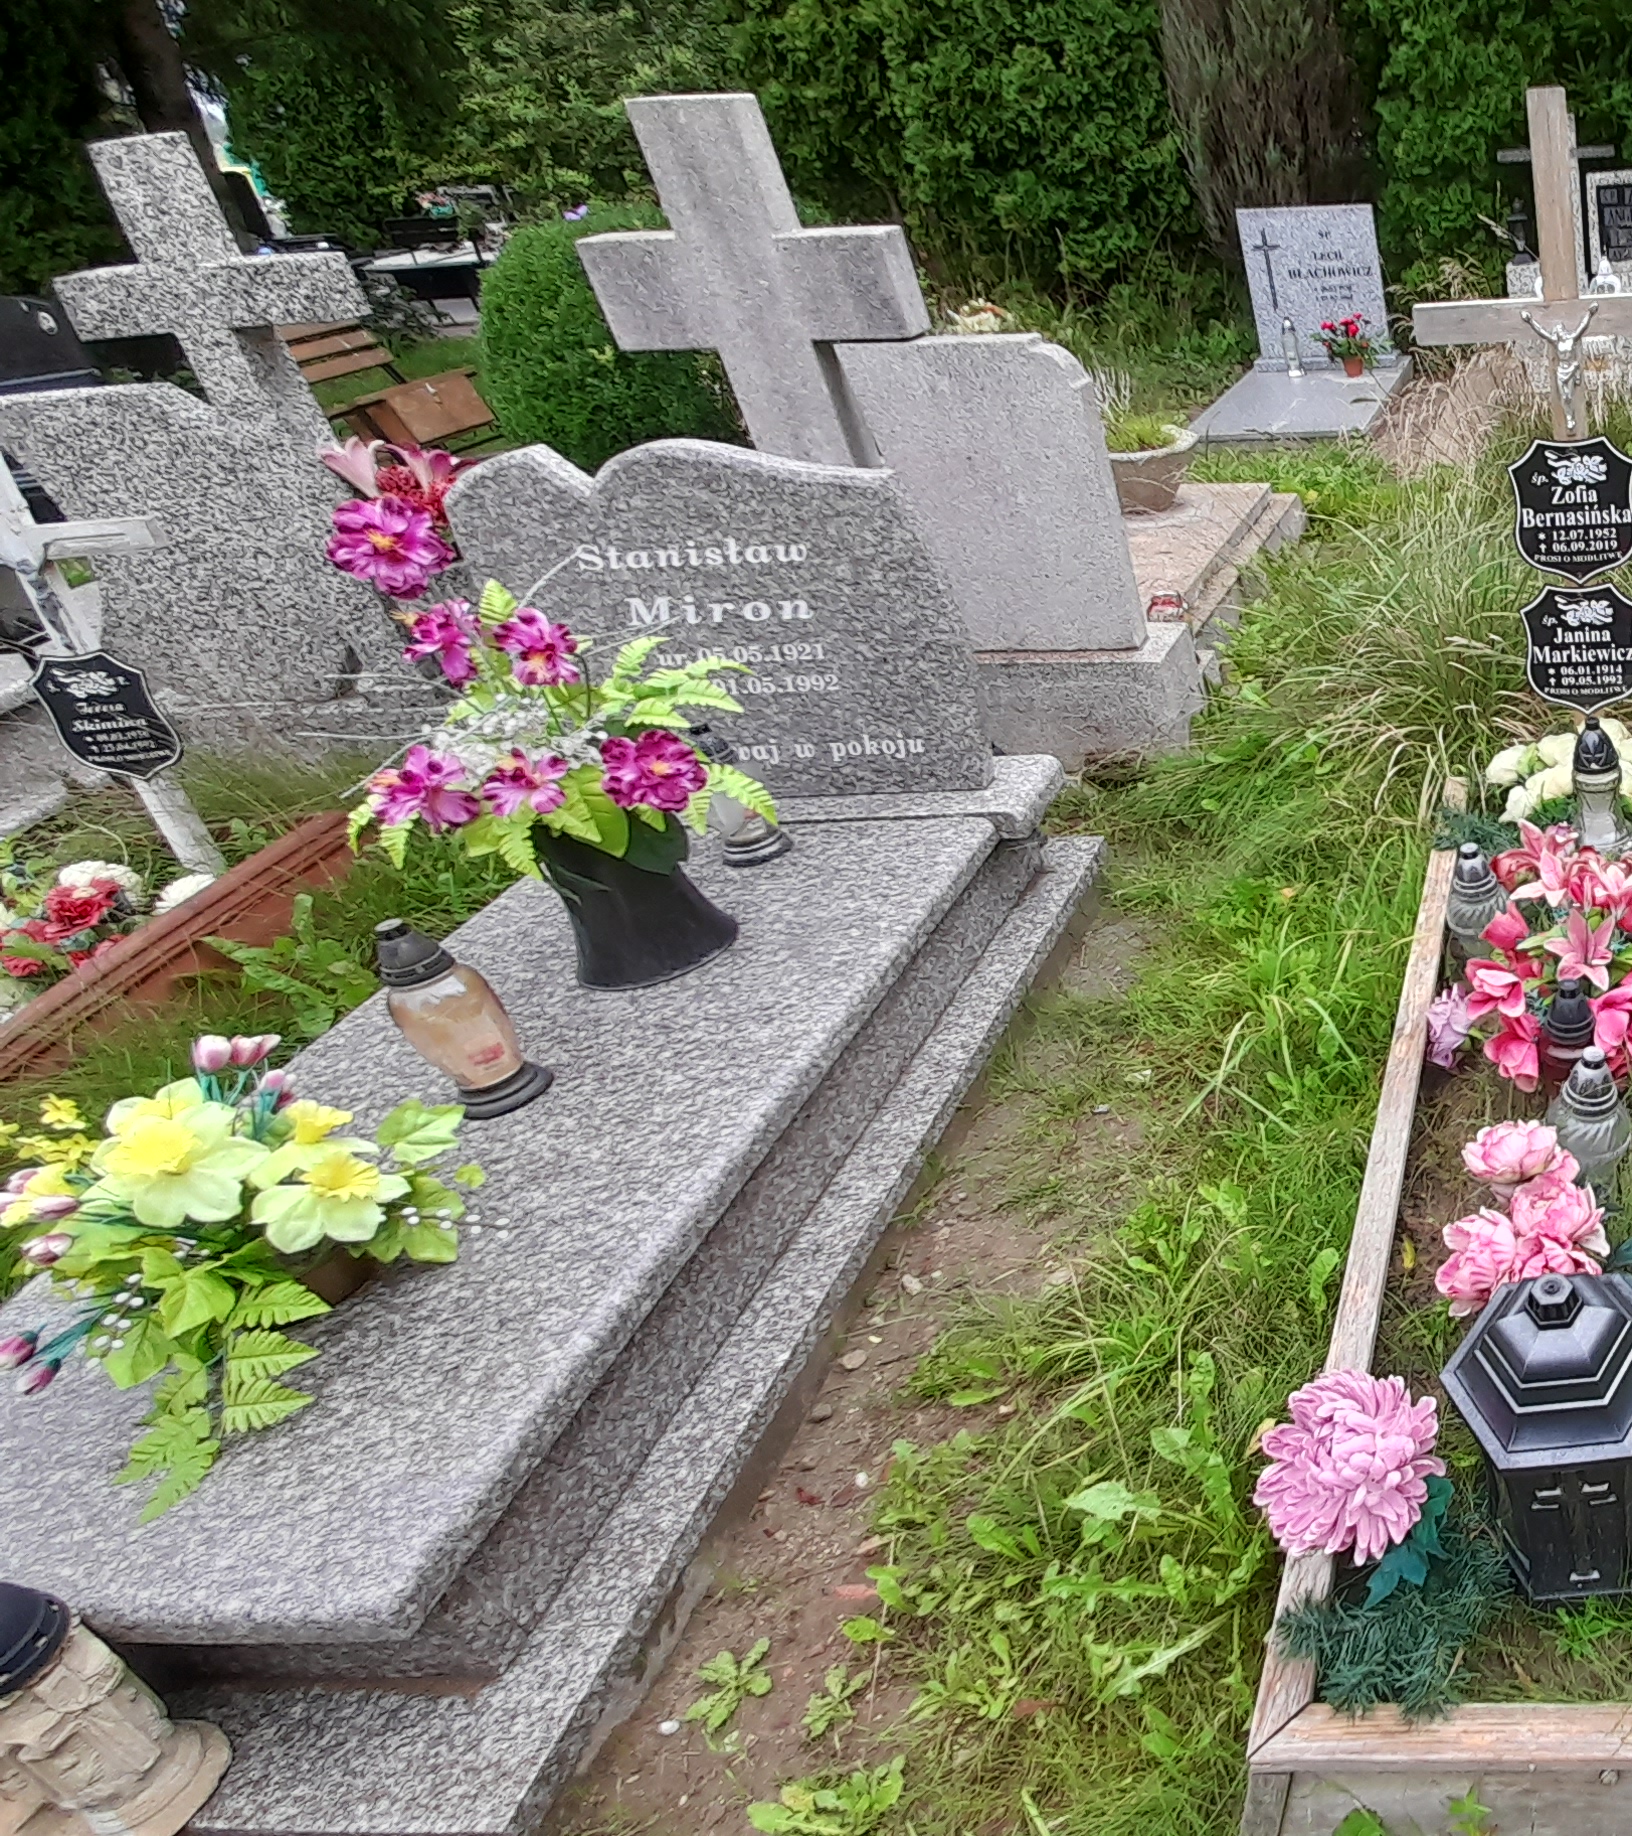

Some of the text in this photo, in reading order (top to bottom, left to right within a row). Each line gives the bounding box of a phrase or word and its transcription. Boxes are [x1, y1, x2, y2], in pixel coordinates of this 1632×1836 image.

[1551, 485, 1598, 505] Zofia
[1522, 503, 1632, 528] Bernasińska
[1552, 527, 1617, 541] 12.07.1952
[577, 538, 808, 572] Stanisław
[1552, 539, 1618, 553] 06.09.2019
[1533, 554, 1562, 562] PROSI
[1563, 554, 1571, 562] O
[625, 595, 815, 627] Miron
[1553, 626, 1611, 644] Janina
[1560, 664, 1623, 676] 06.01.1914
[1561, 675, 1623, 687] 09.05.1992
[793, 743, 816, 759] w
[829, 733, 926, 763] pokoju
